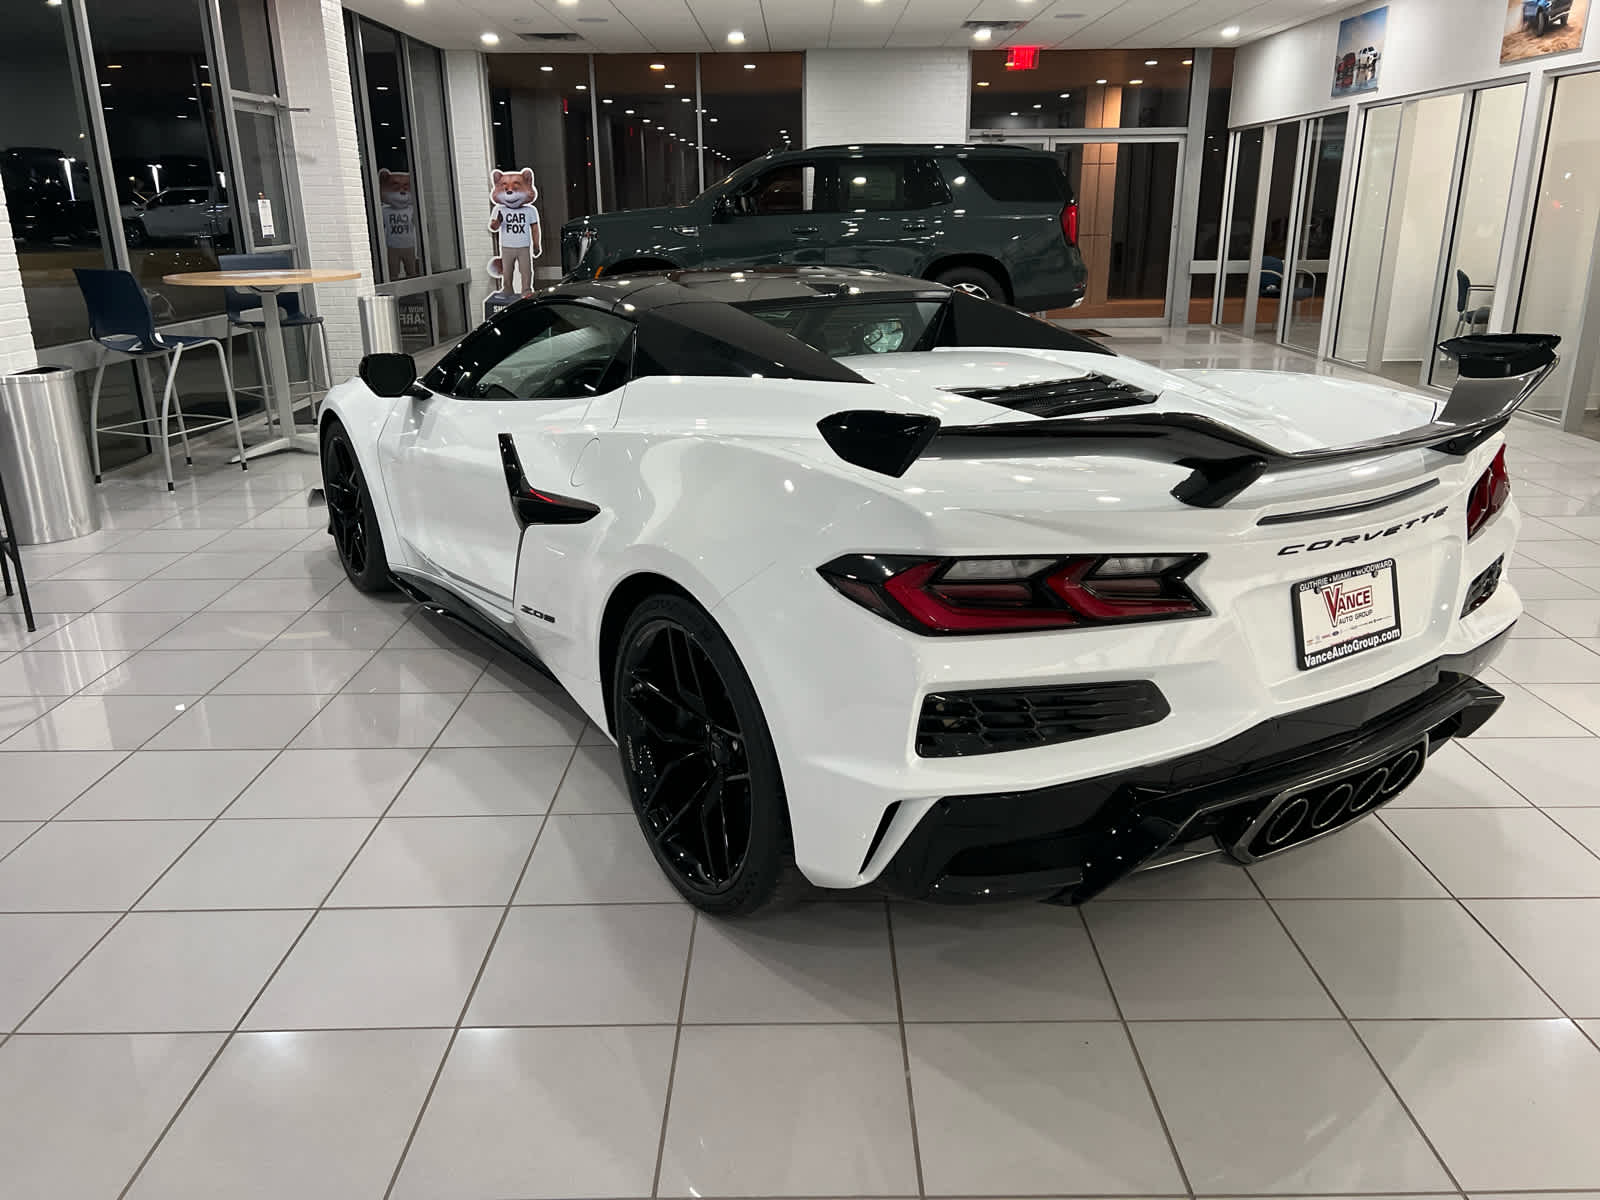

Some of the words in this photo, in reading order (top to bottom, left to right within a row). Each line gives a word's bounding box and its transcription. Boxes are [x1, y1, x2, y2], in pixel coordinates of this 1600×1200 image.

[506, 213, 526, 223] CAR
[507, 224, 525, 234] FOX
[1277, 505, 1449, 556] CORVETTE
[1300, 577, 1329, 592] GUTHRIE
[1333, 571, 1351, 581] MIAMI
[1356, 560, 1393, 576] WOODWARD
[1325, 588, 1371, 622] VANCE
[1339, 615, 1353, 625] AUTO
[1355, 609, 1373, 619] GROUP
[1304, 628, 1400, 668] VanceAutoGroup.com
